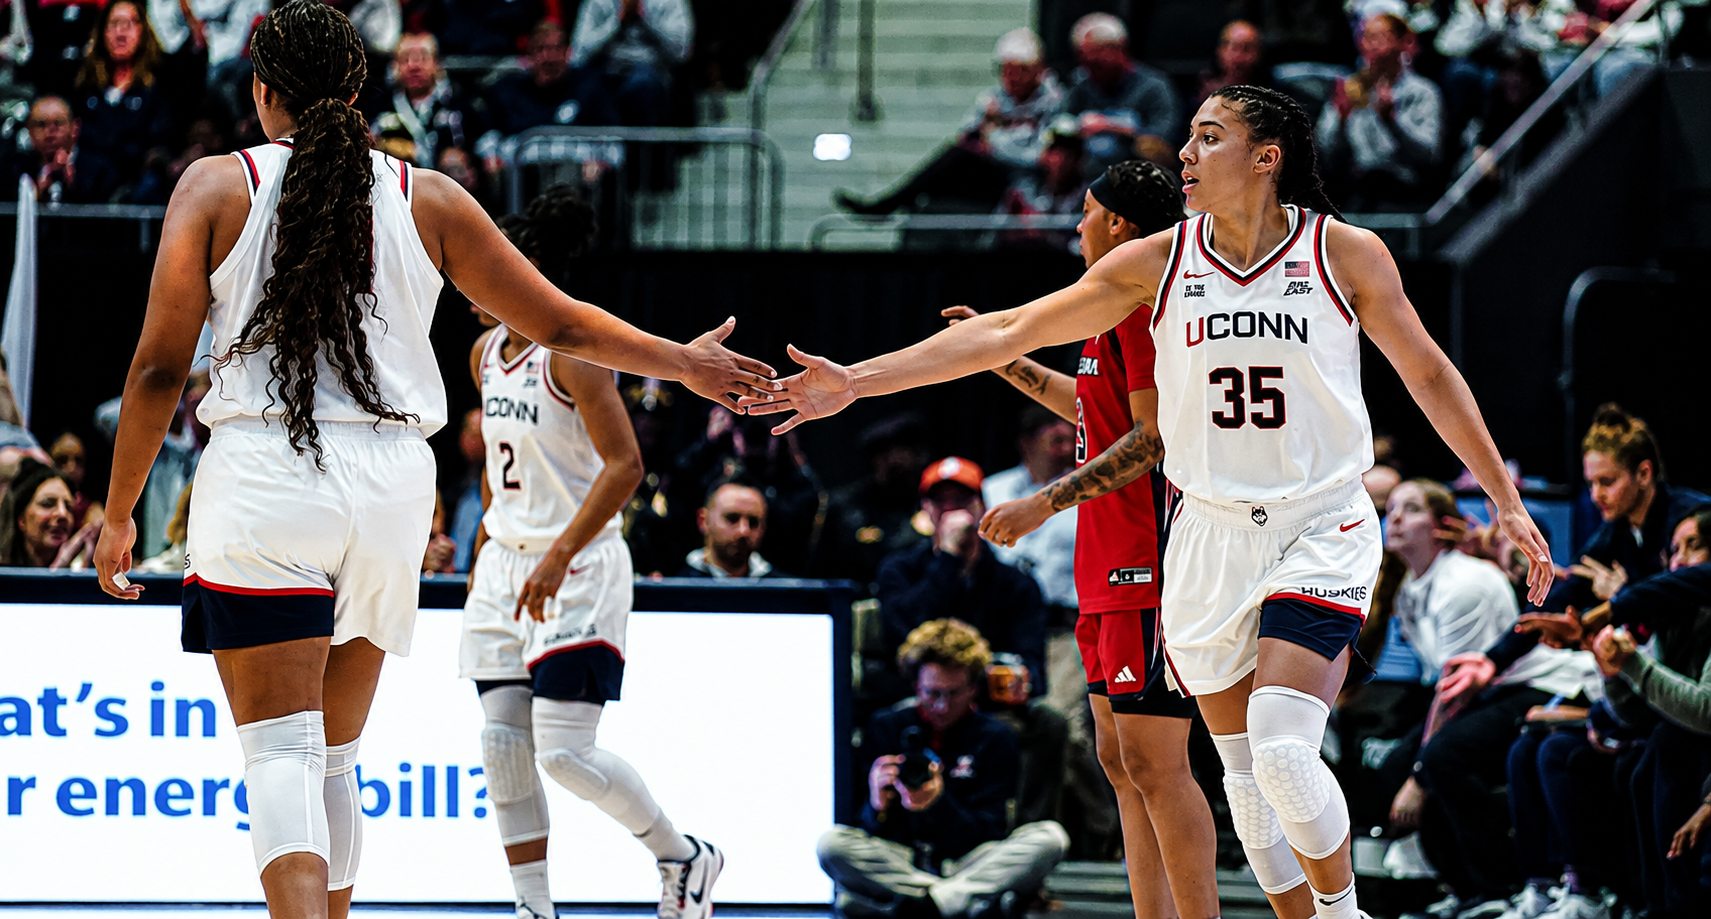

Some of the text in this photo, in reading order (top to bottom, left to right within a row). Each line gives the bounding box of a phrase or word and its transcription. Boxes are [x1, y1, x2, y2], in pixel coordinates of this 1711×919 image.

[1283, 286, 1314, 297] EAST
[1186, 311, 1308, 348] UCONN
[484, 396, 538, 425] CONN
[1208, 366, 1287, 430] 35
[498, 441, 522, 491] 2
[1301, 586, 1367, 602] HUSKIES
[150, 681, 216, 738] in
[354, 762, 489, 819] bill?
